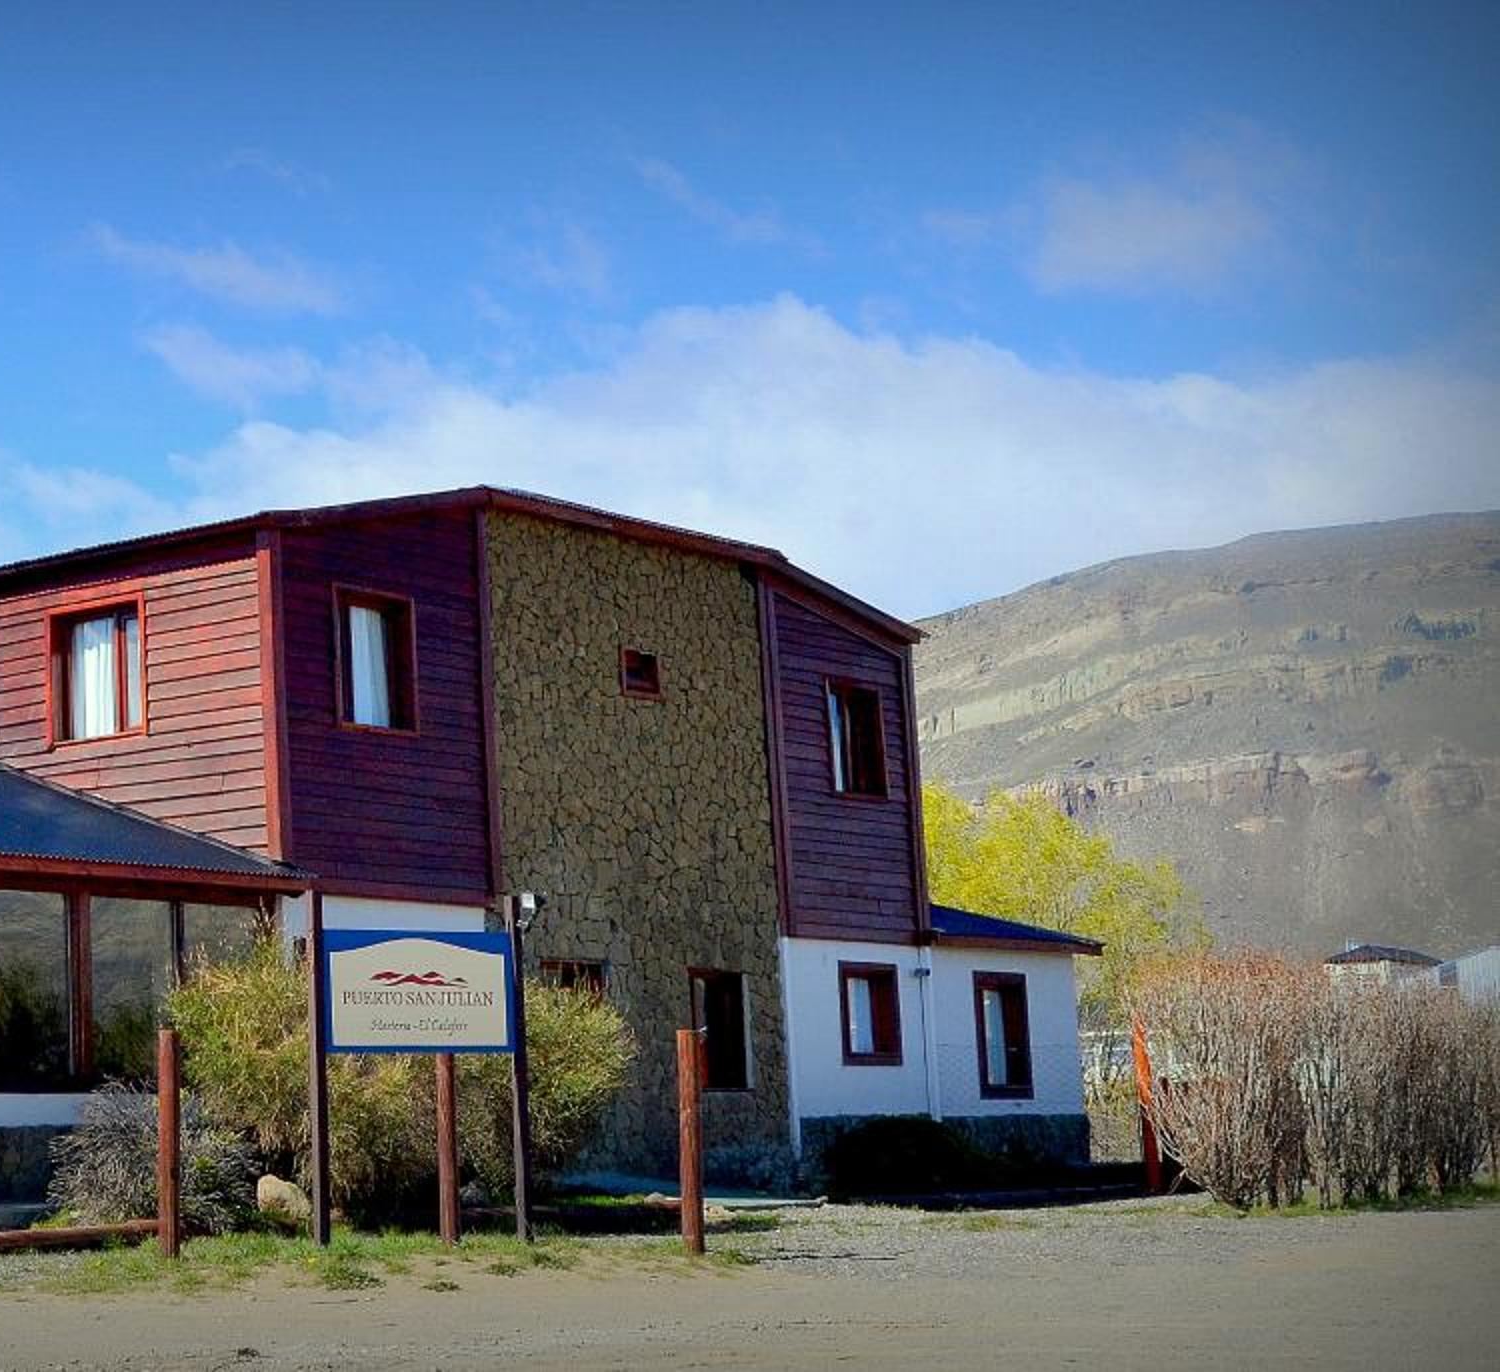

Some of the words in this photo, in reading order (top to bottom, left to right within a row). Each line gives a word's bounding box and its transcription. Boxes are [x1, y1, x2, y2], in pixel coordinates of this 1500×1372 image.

[342, 991, 403, 1006] PUERTO
[405, 991, 436, 1006] SAN
[438, 991, 493, 1007] JULIAN
